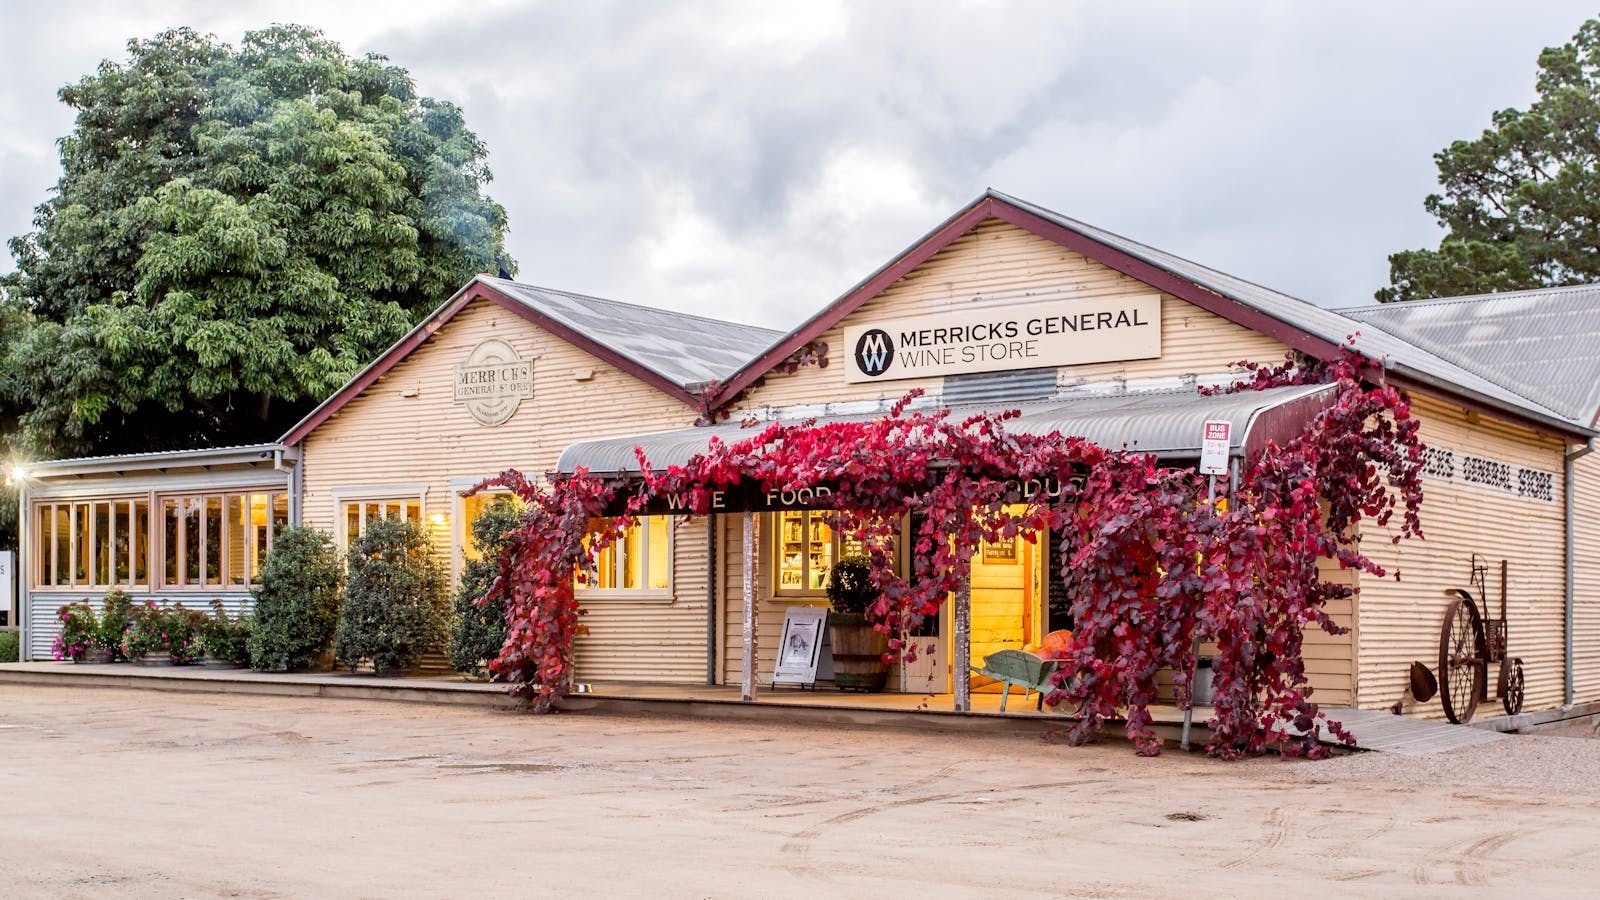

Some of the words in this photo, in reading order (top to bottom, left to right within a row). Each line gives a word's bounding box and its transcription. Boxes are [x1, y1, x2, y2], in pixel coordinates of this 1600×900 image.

[900, 320, 1018, 349] MERRICKS
[1026, 308, 1148, 336] GENERAL
[899, 347, 955, 368] WINE
[961, 339, 1039, 363] STORE
[1210, 424, 1226, 432] BUS
[666, 491, 726, 510] WE
